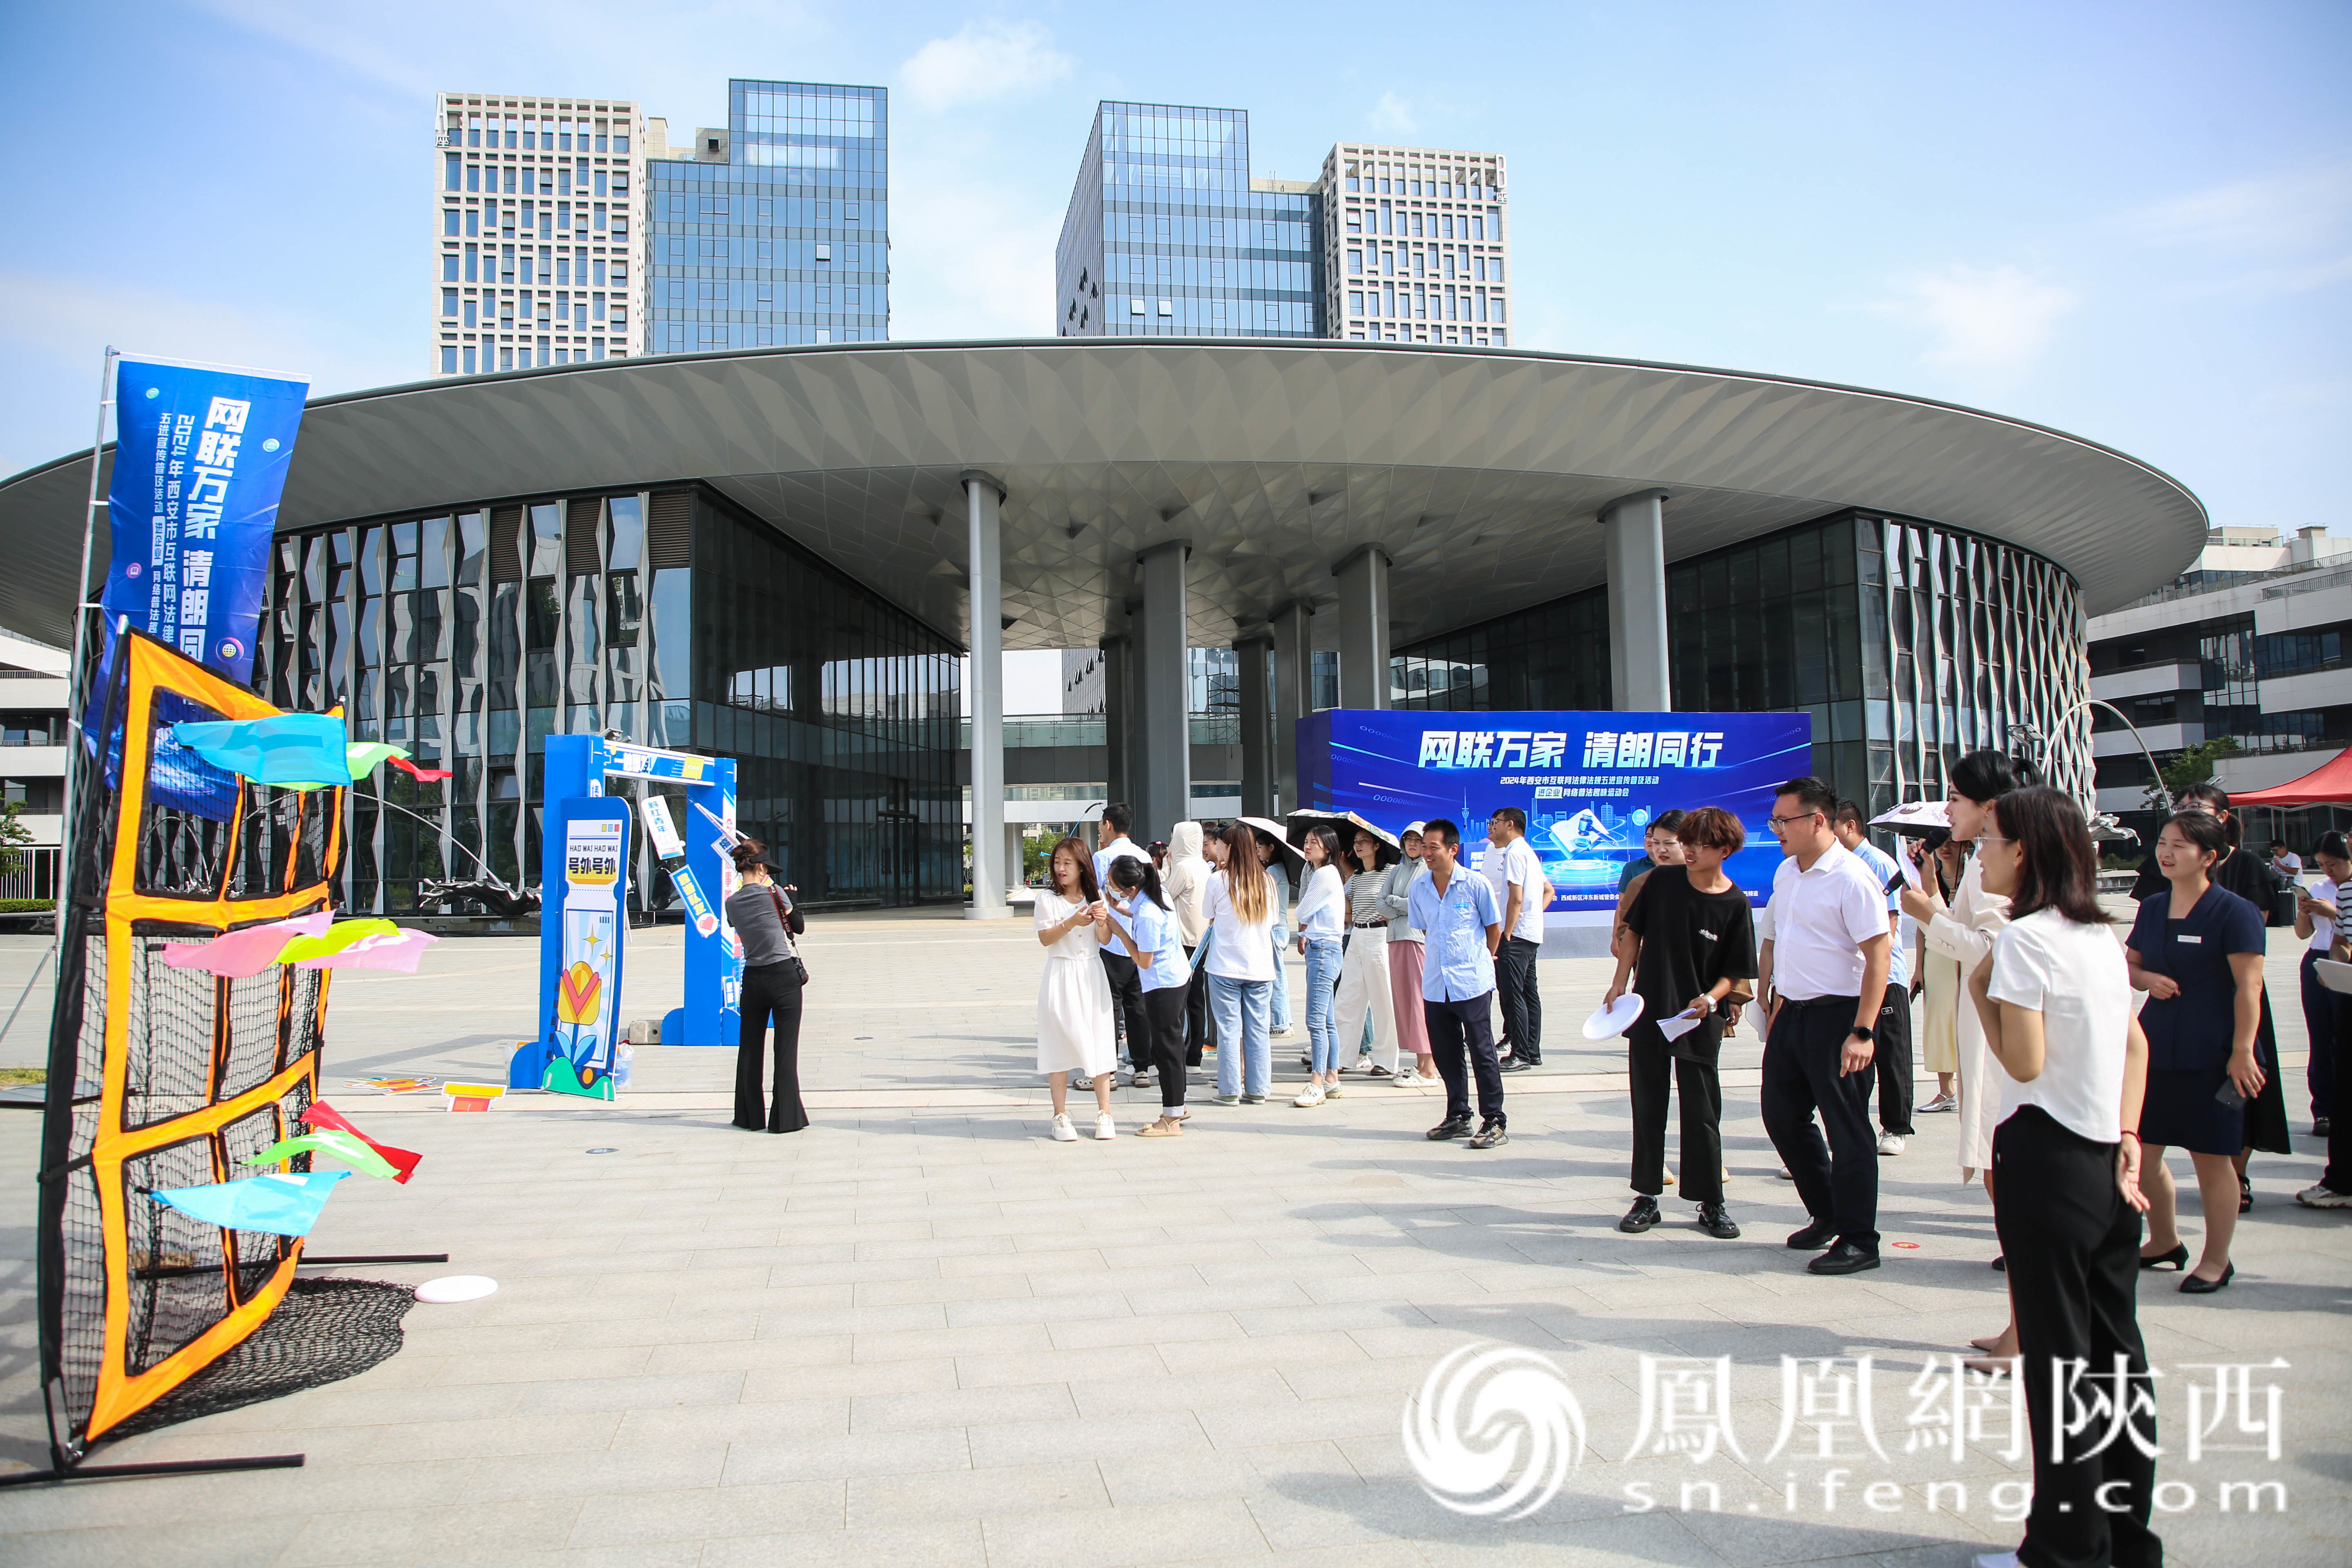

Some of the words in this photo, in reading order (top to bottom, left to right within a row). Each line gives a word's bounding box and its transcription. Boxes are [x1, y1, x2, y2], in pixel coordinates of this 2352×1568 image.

[435, 92, 450, 148] A座
[1496, 154, 1508, 204] B座
[185, 396, 252, 539] 网联万家
[1418, 730, 1567, 768] 网联万家
[1582, 731, 1724, 768] 清朗同行
[1500, 775, 1659, 785] 2024年西安市互联网法律法规五进宣传普及活动
[1537, 788, 1561, 796] 进企业
[1563, 788, 1629, 797] 网络普法趣味运动会
[569, 857, 616, 875] 号外号外
